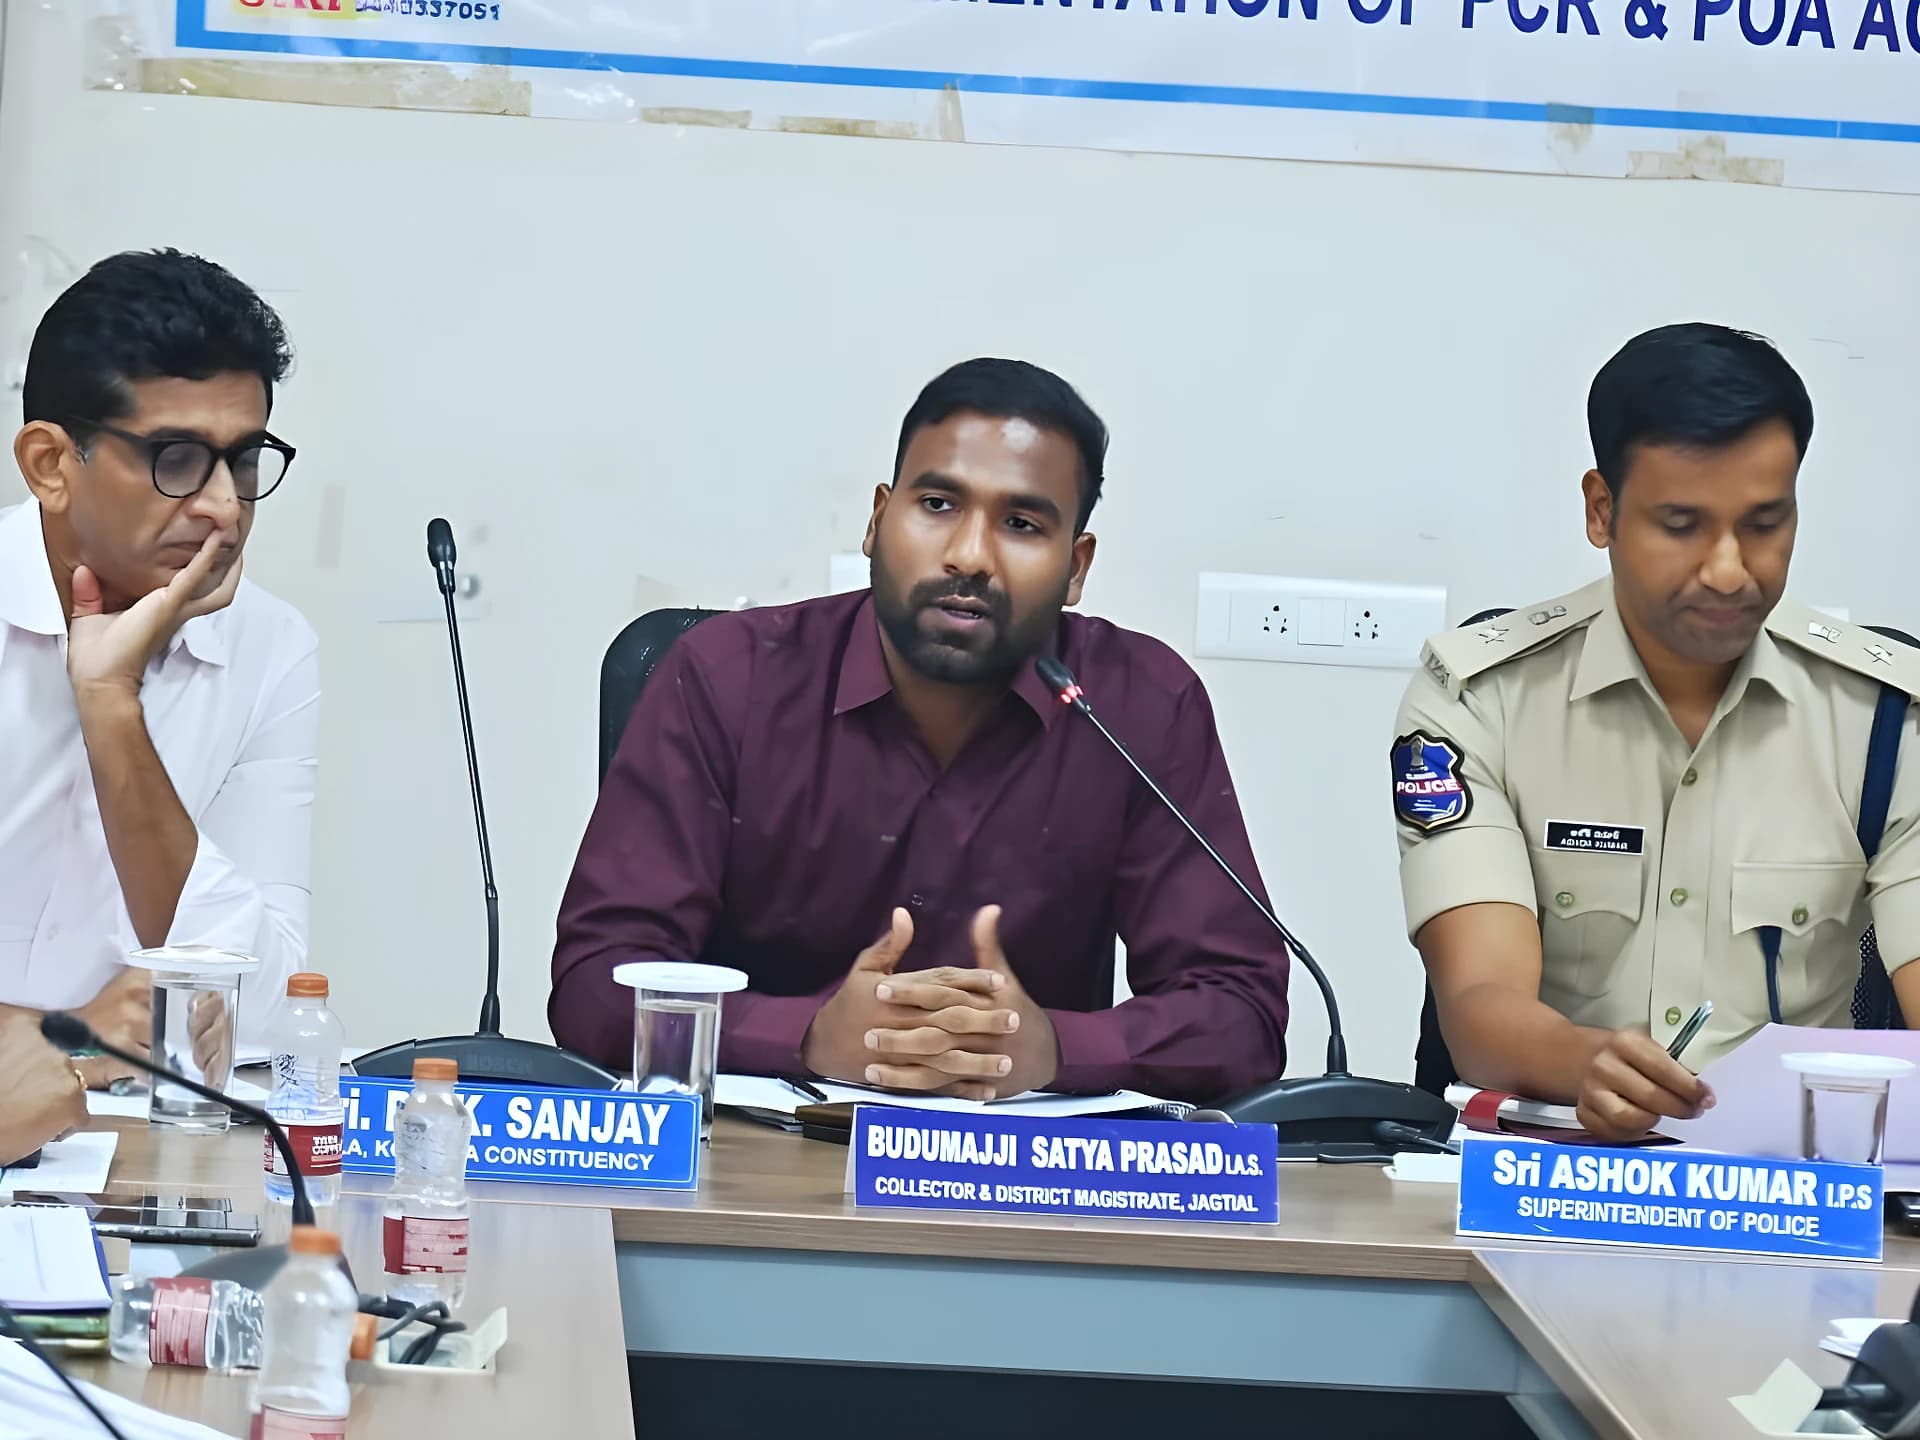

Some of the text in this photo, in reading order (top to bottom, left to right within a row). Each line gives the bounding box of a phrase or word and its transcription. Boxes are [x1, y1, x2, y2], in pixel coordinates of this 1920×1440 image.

[1693, 0, 1835, 49] POA
[1853, 0, 1920, 55] A
[1396, 779, 1460, 794] POLICE
[505, 1096, 670, 1146] SANJAY
[484, 1145, 655, 1171] CONSTITUENCY
[867, 1124, 1018, 1167] BUDUMAJJI
[1031, 1135, 1115, 1172] SATYA
[1120, 1140, 1224, 1176] PRASAD
[875, 1176, 1259, 1213] COLLECTOR & DISTRICT MAGISTRATE, JAGTIAL
[1493, 1149, 1542, 1187] Sri
[1549, 1154, 1678, 1198] ASHOK
[1685, 1163, 1818, 1207] KUMAR
[1517, 1196, 1821, 1237] SUPERINTENDENT OF POLICE
